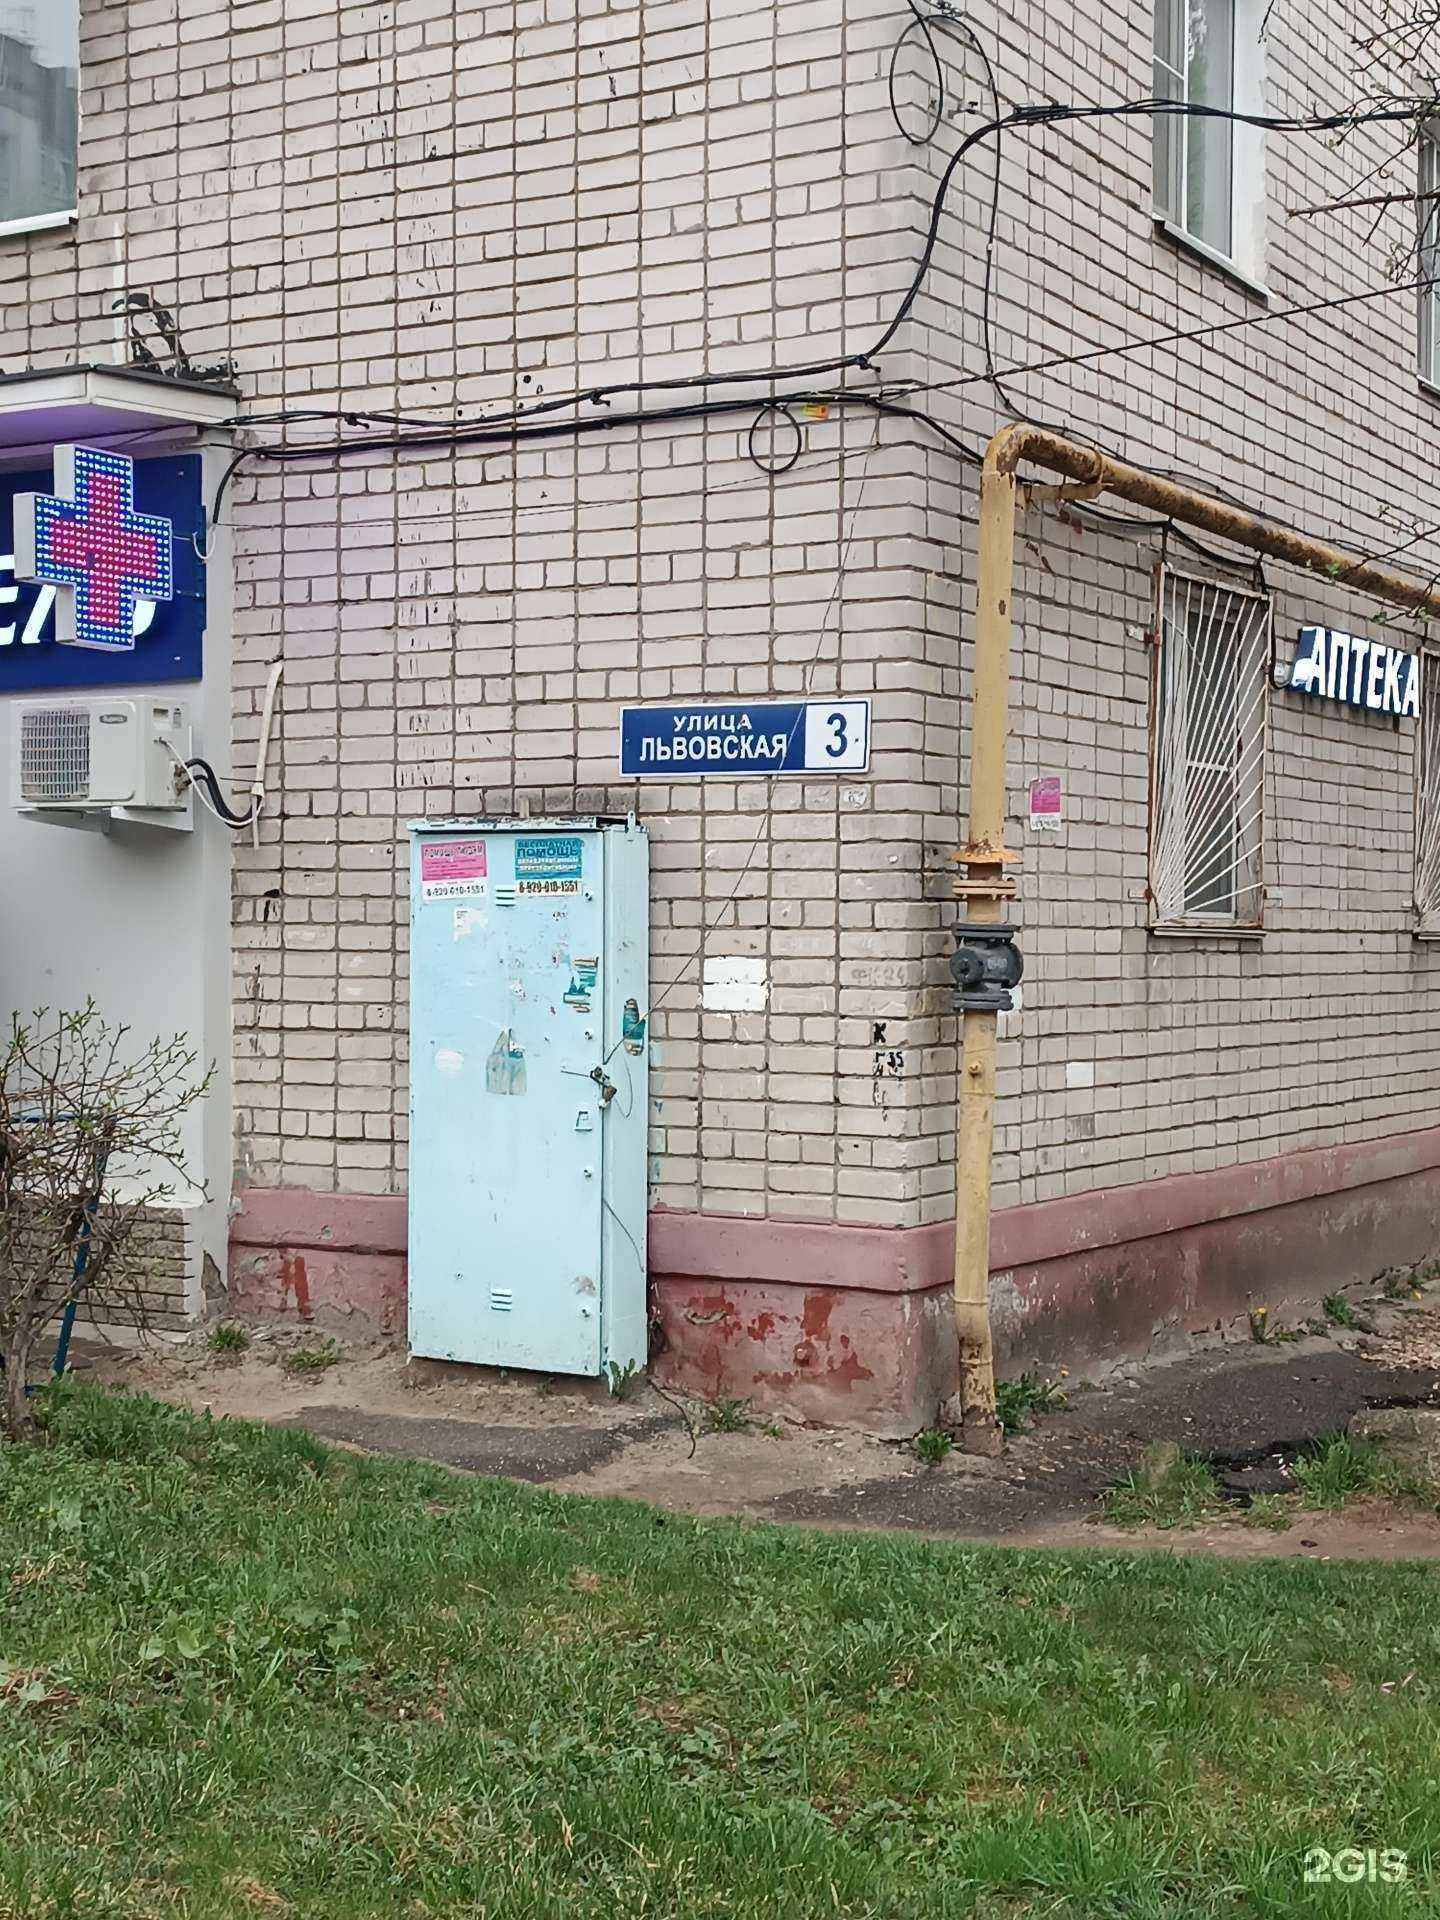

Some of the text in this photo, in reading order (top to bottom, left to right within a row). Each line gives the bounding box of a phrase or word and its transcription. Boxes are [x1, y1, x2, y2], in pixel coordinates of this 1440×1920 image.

[1302, 626, 1420, 718] АПТЕКА
[674, 714, 752, 733] УЛИЦА
[825, 712, 848, 757] 3
[639, 733, 787, 761] ЛЬВОВСКАЯ
[517, 846, 579, 858] ПОМОЩЬ
